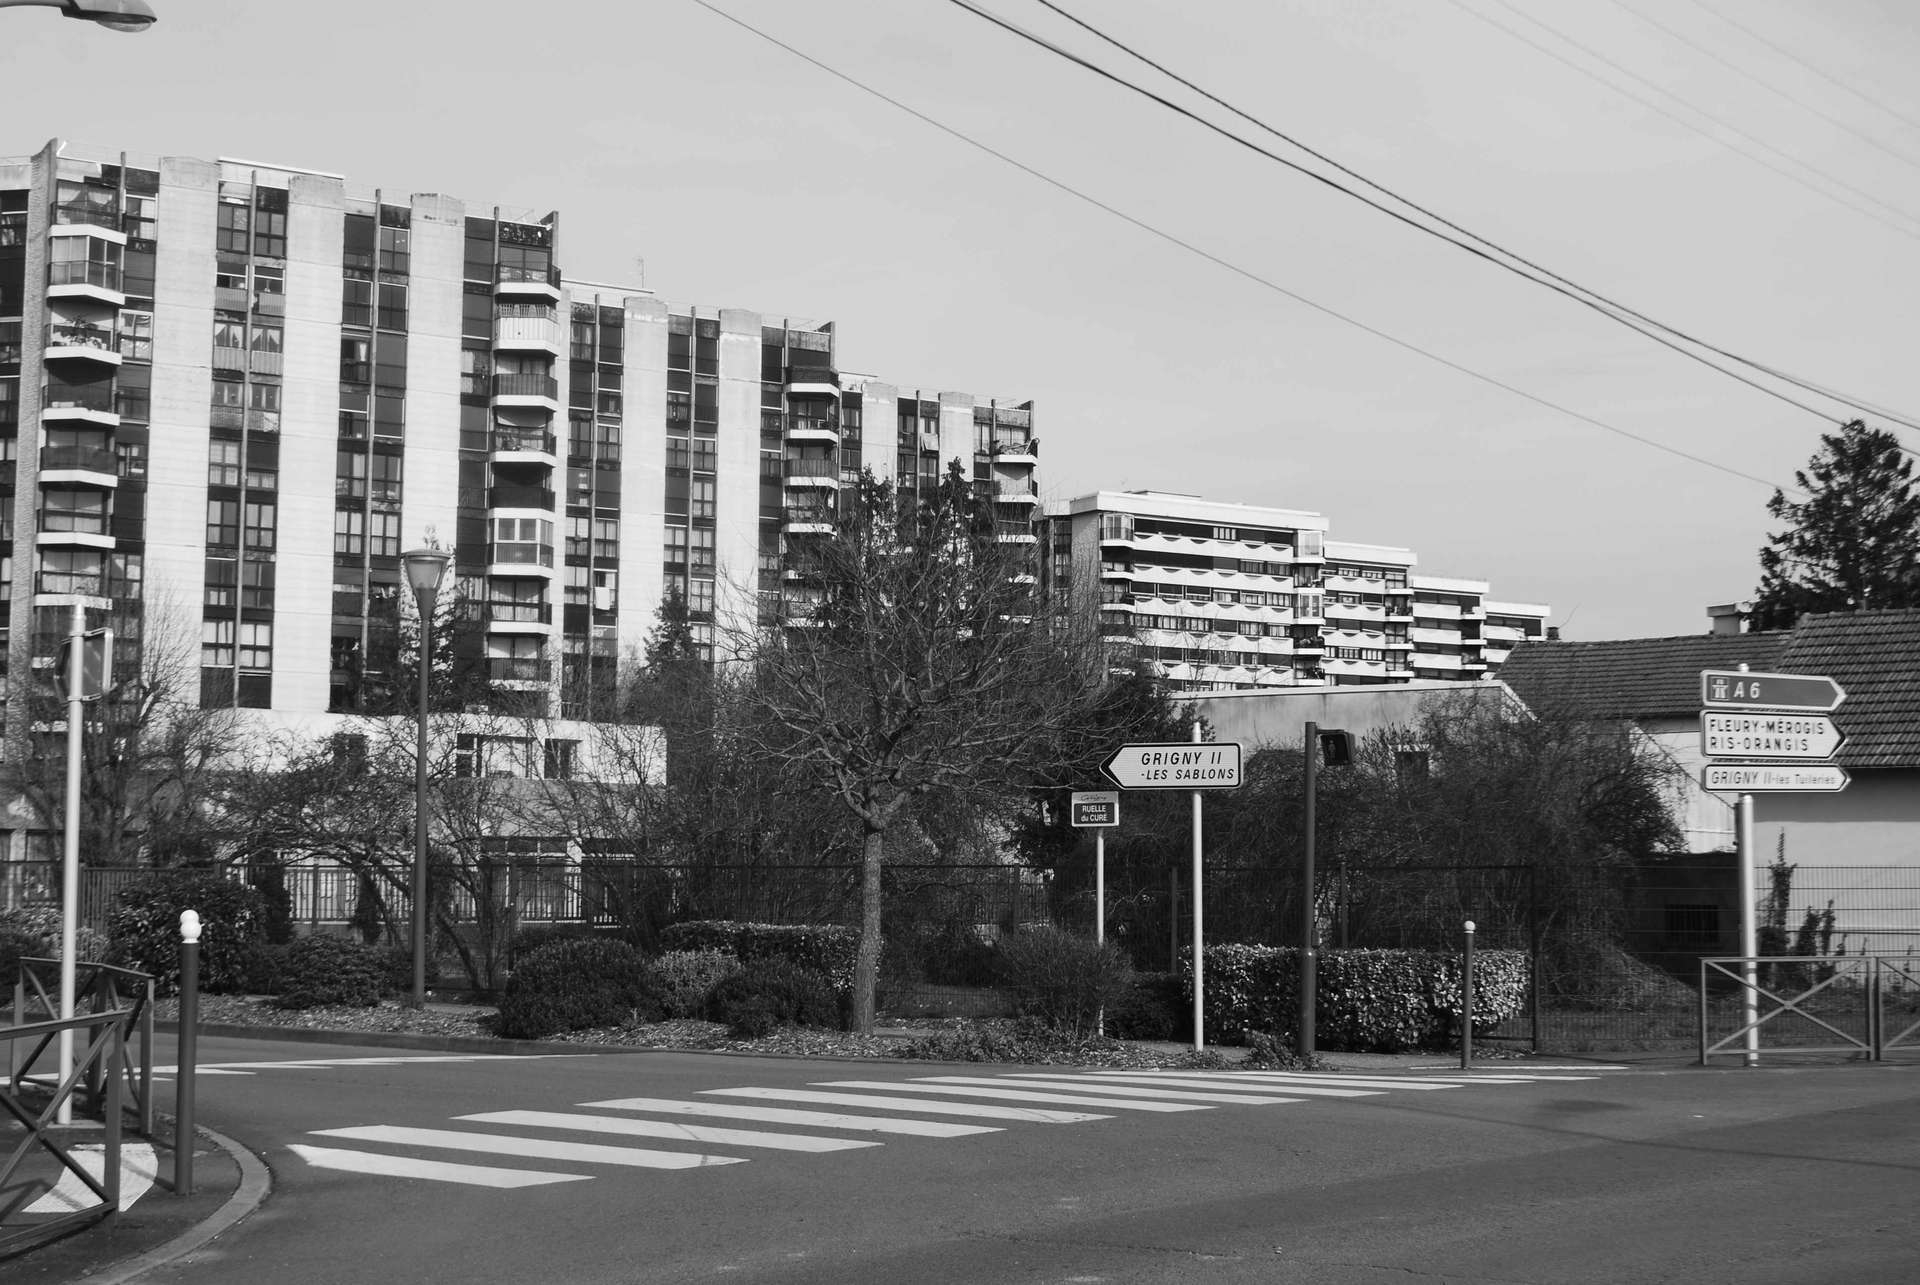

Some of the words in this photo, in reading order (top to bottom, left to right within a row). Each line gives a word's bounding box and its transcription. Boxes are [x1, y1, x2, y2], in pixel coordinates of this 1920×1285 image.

[1733, 681, 1745, 698] A
[1750, 681, 1761, 699] 6
[1709, 718, 1825, 735] FLEURY-MÉROGIS
[1710, 736, 1808, 751] RIS-ORANGIS
[1141, 751, 1202, 766] GRIGNY
[1210, 751, 1222, 765] II
[1175, 768, 1235, 780] SABLONS
[1711, 771, 1759, 785] GRIGNY
[1082, 804, 1107, 813] RUELLE
